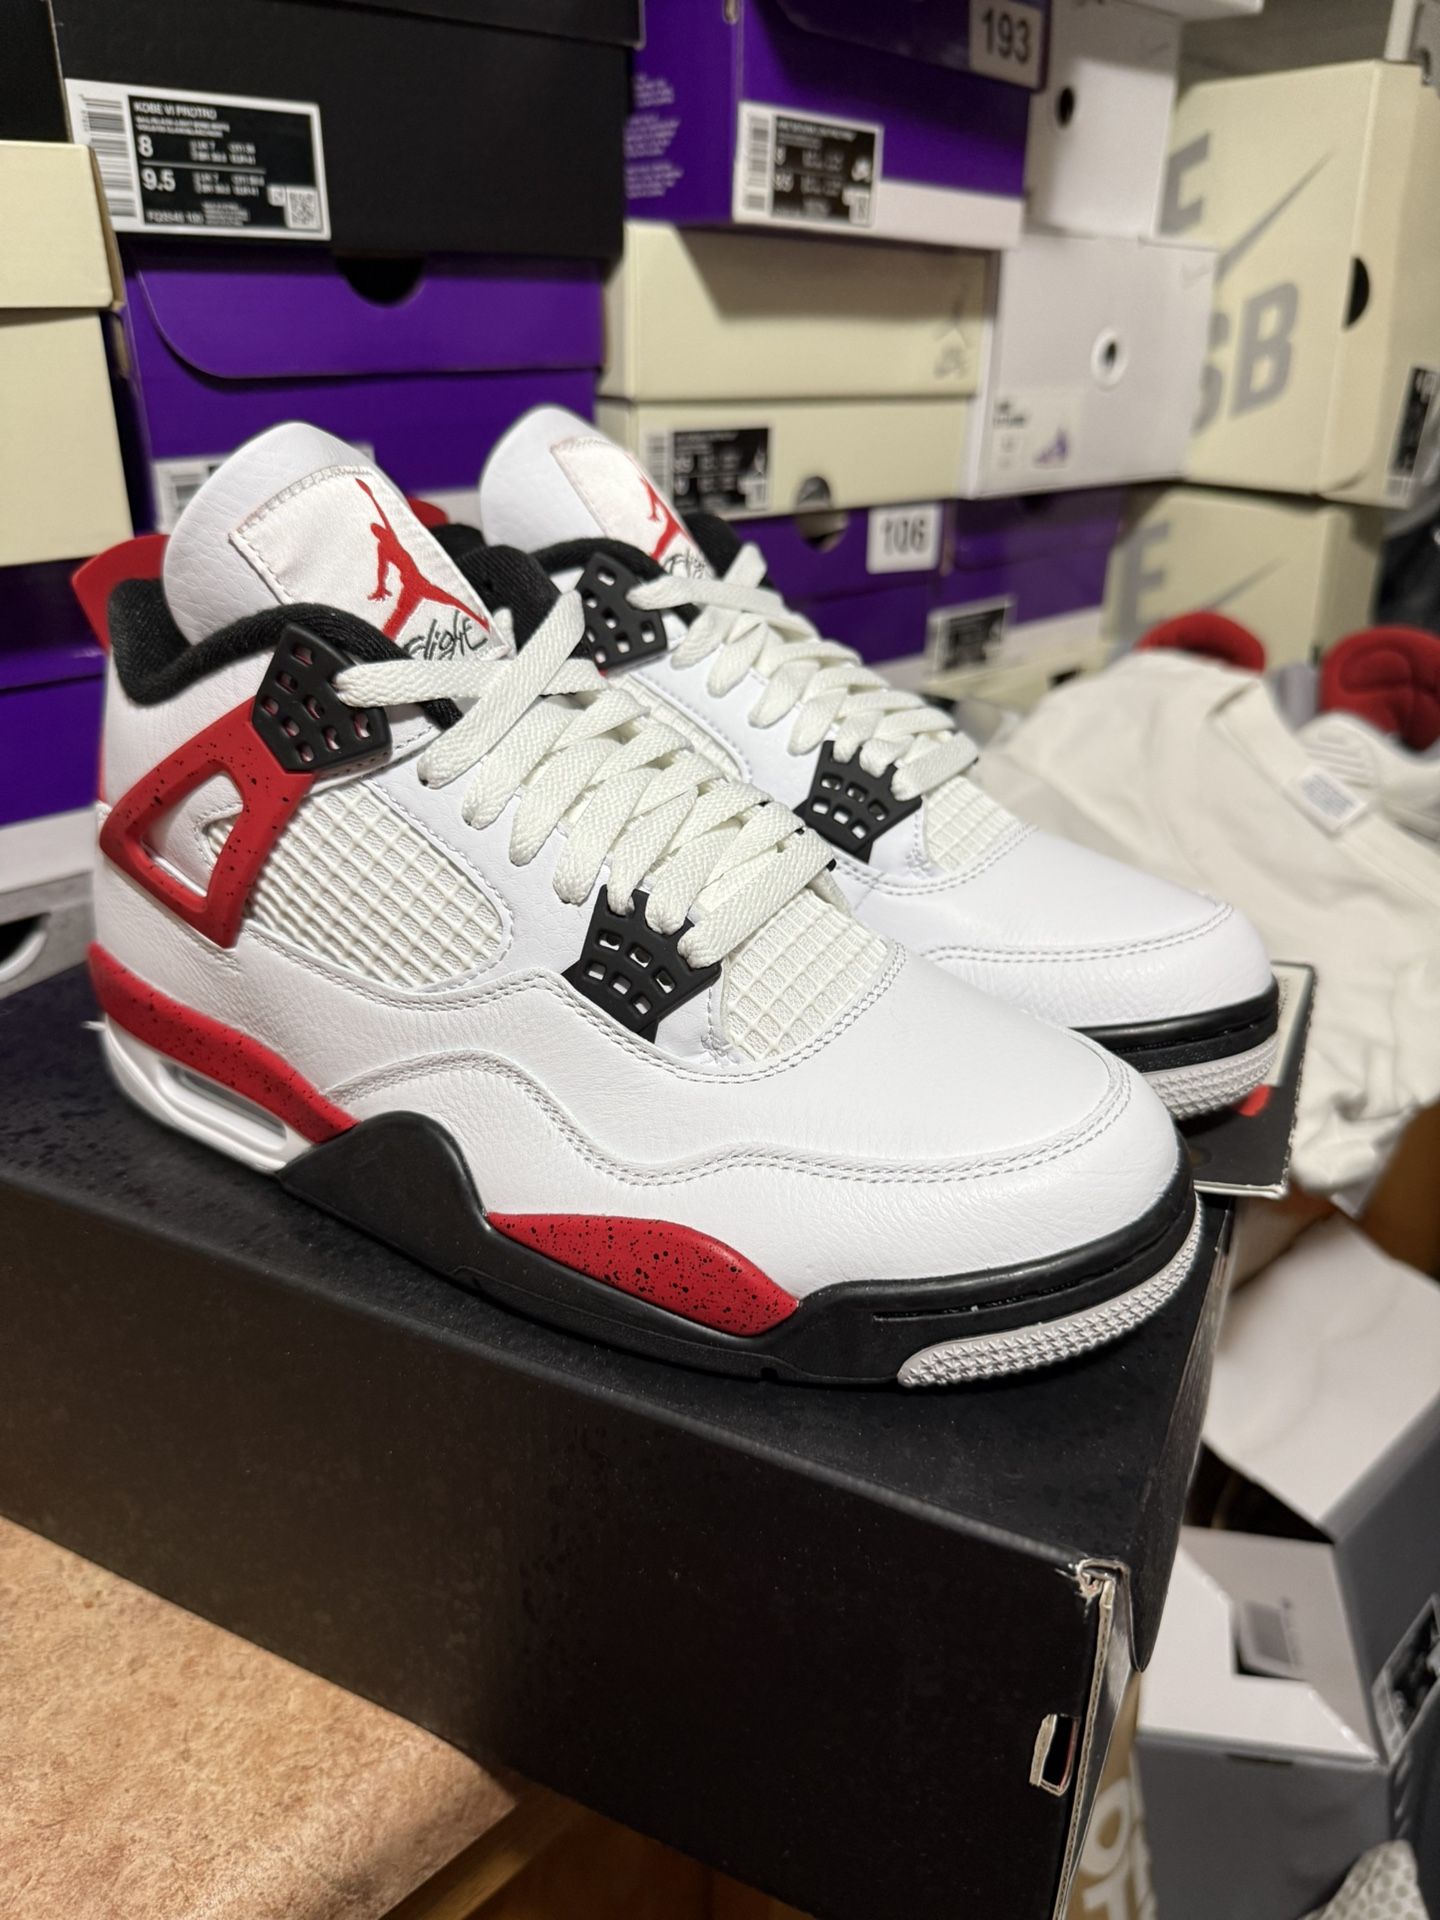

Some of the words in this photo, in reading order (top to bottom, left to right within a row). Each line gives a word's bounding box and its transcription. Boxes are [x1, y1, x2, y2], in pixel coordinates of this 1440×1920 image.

[983, 8, 1031, 64] 193
[138, 134, 153, 157] 8
[141, 168, 176, 191] 9.5
[883, 518, 926, 555] 106
